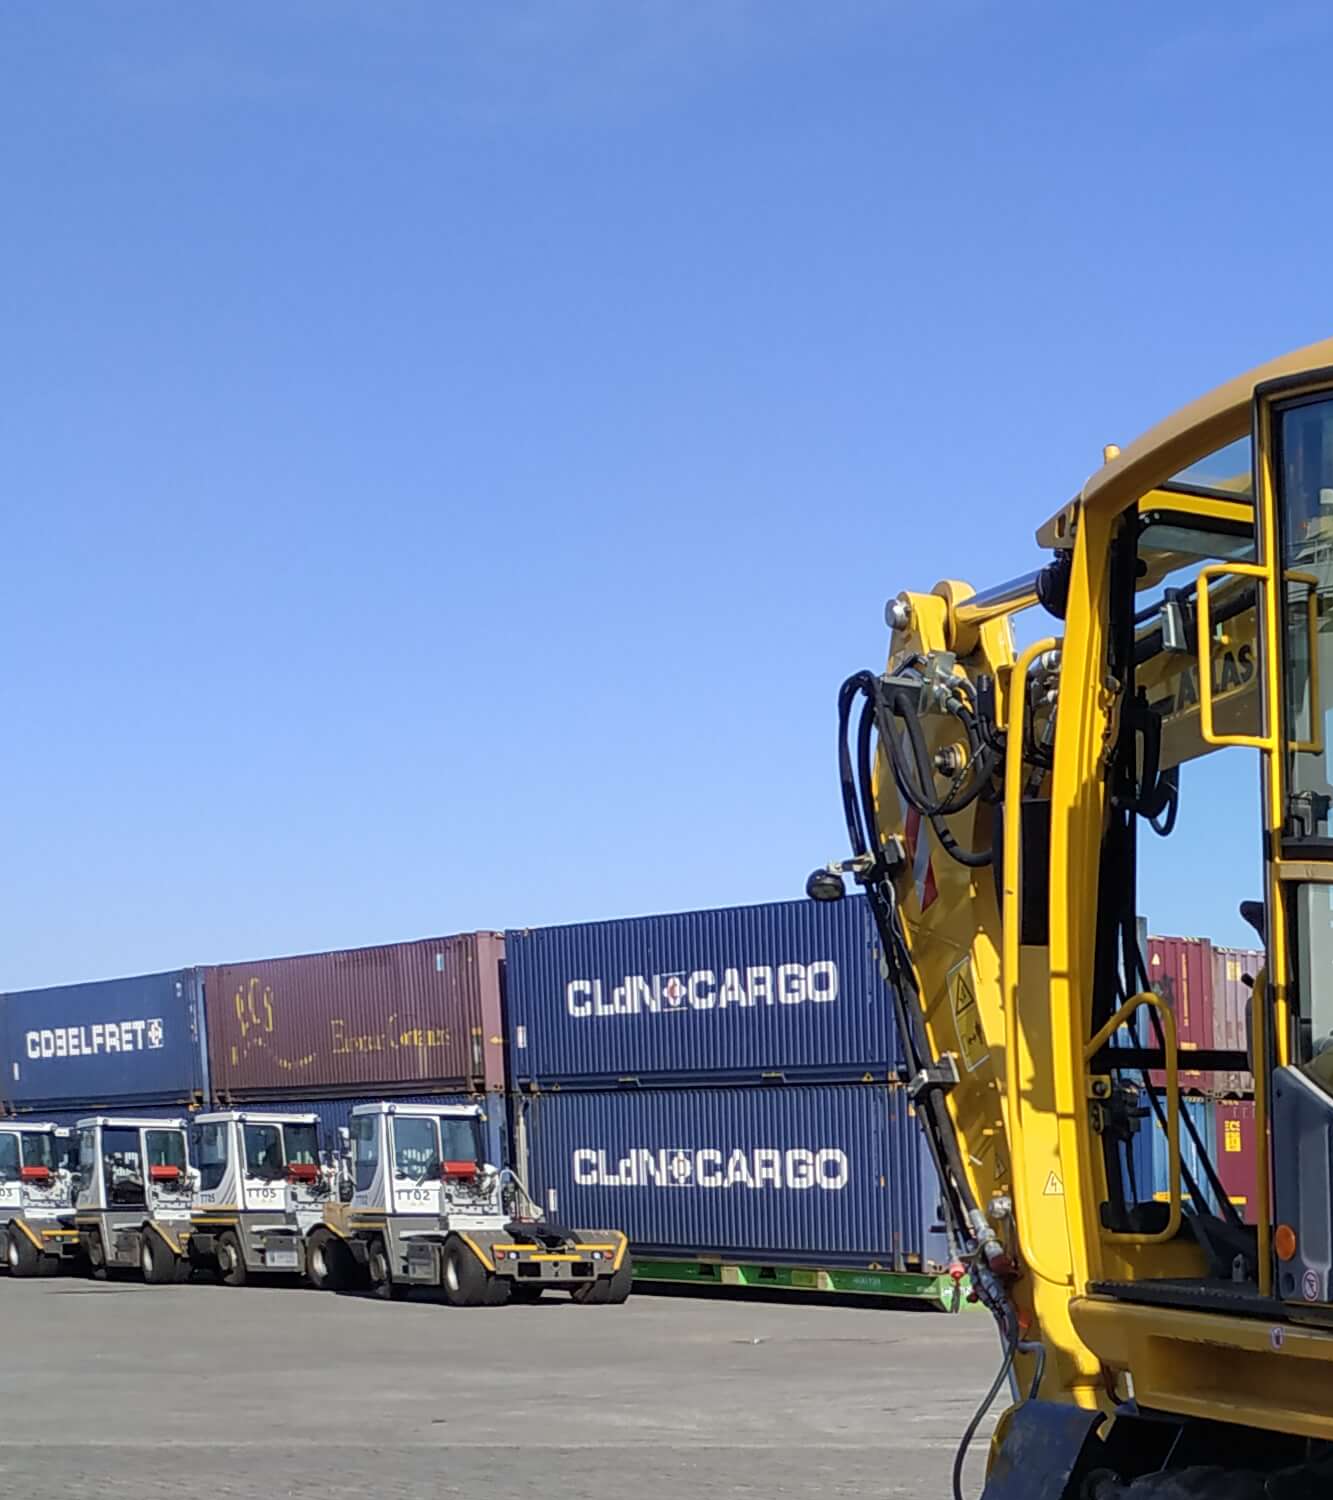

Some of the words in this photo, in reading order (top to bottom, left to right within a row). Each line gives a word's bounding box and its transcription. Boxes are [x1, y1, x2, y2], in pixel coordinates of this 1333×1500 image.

[1175, 644, 1255, 711] ALAS
[688, 960, 838, 1010] CARGO
[26, 1019, 146, 1059] COBELFRET
[696, 1148, 849, 1190] CARGO
